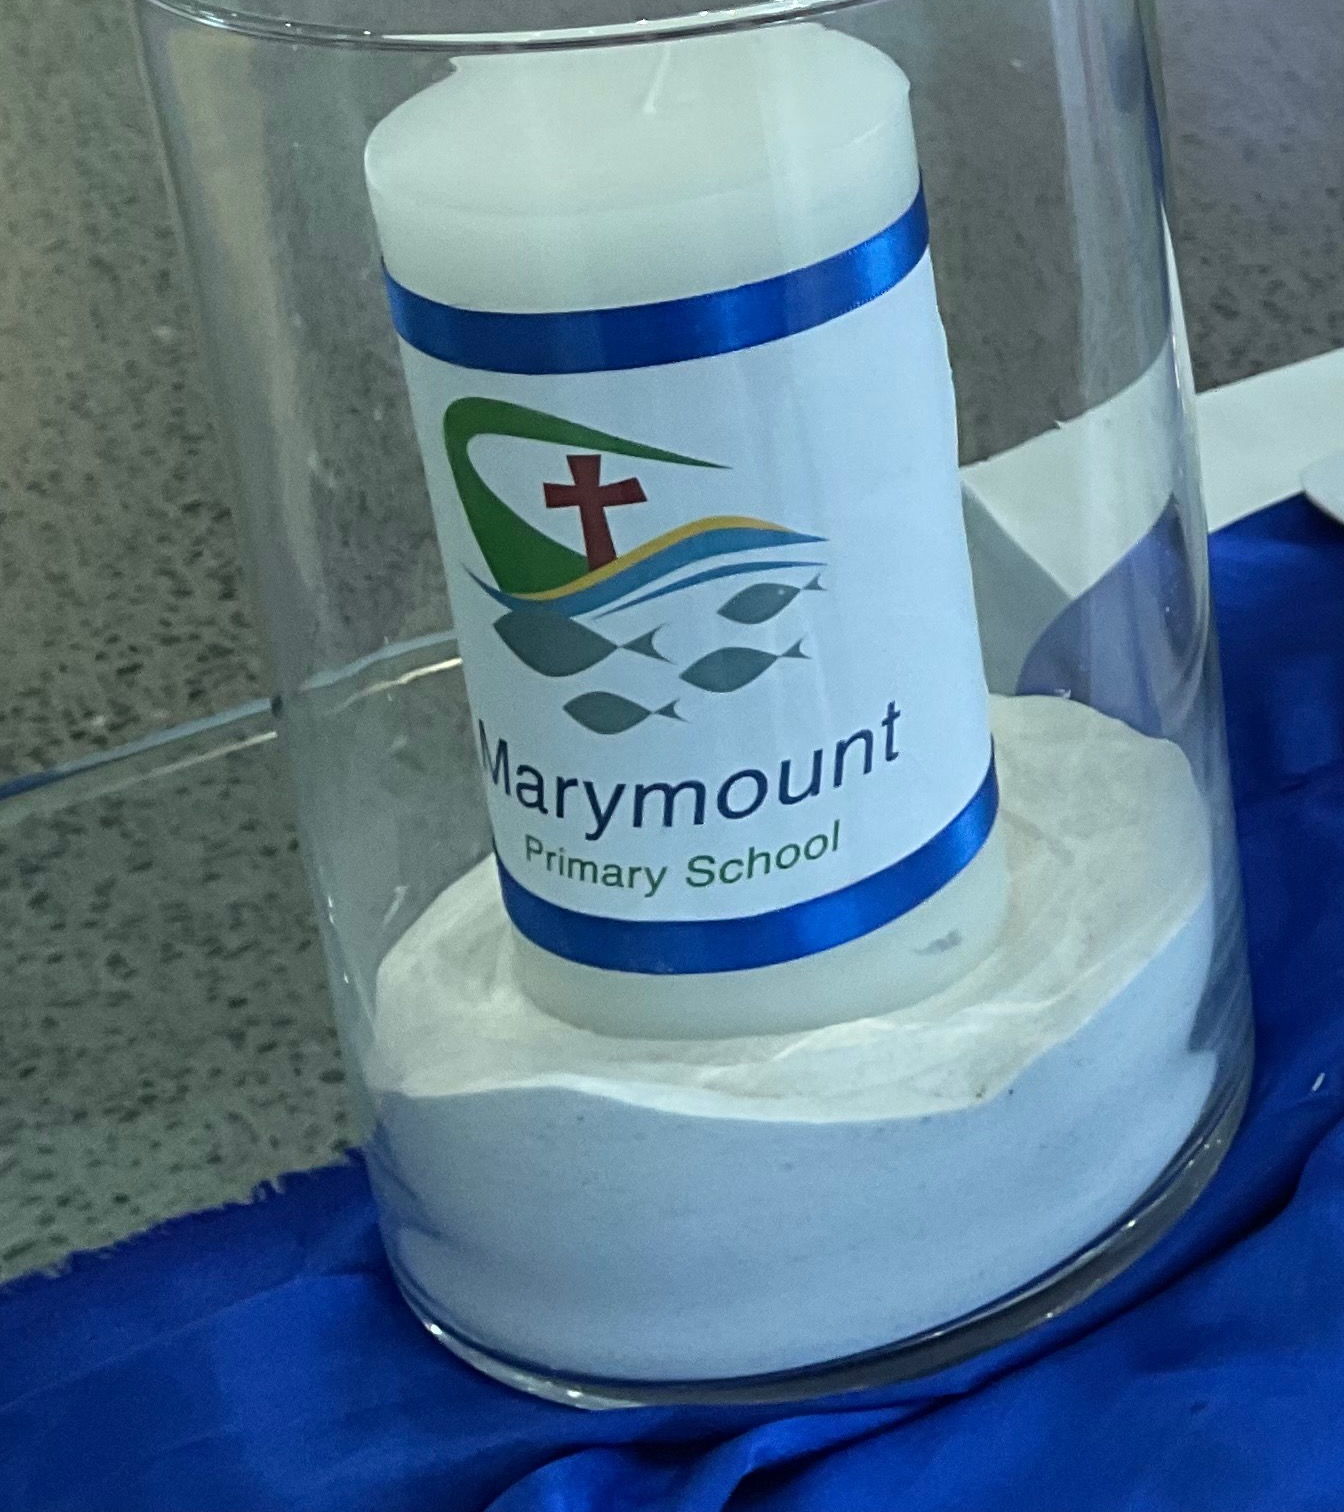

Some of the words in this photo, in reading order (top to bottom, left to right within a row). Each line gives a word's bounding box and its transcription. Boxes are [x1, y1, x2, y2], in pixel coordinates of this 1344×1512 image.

[478, 699, 901, 841] Marymount
[524, 833, 668, 898] Primary
[685, 819, 840, 888] School
